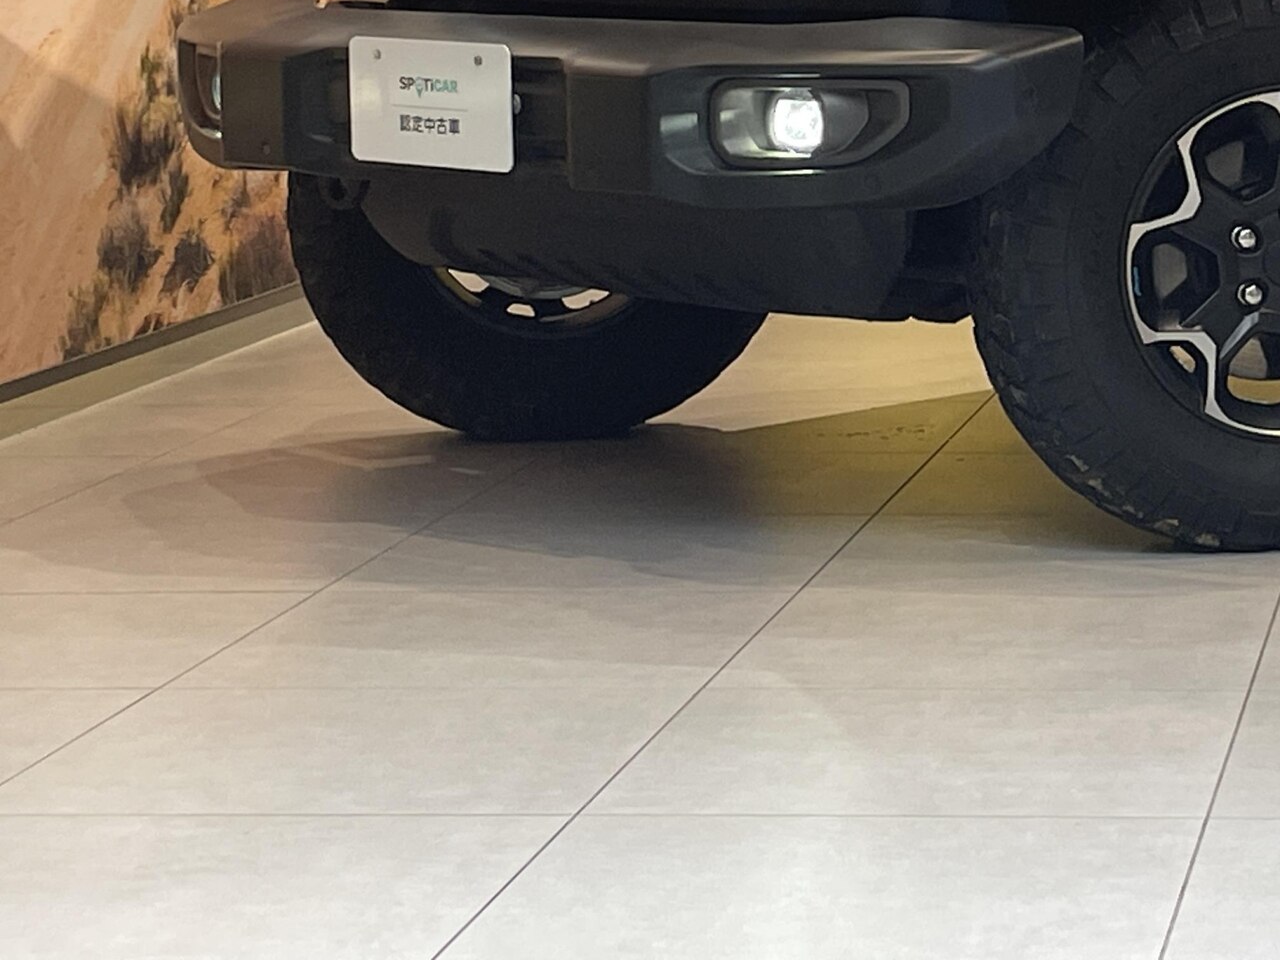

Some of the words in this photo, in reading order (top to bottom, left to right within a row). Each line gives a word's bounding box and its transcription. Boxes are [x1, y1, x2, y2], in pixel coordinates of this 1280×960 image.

[400, 114, 460, 134] 認定中古車
